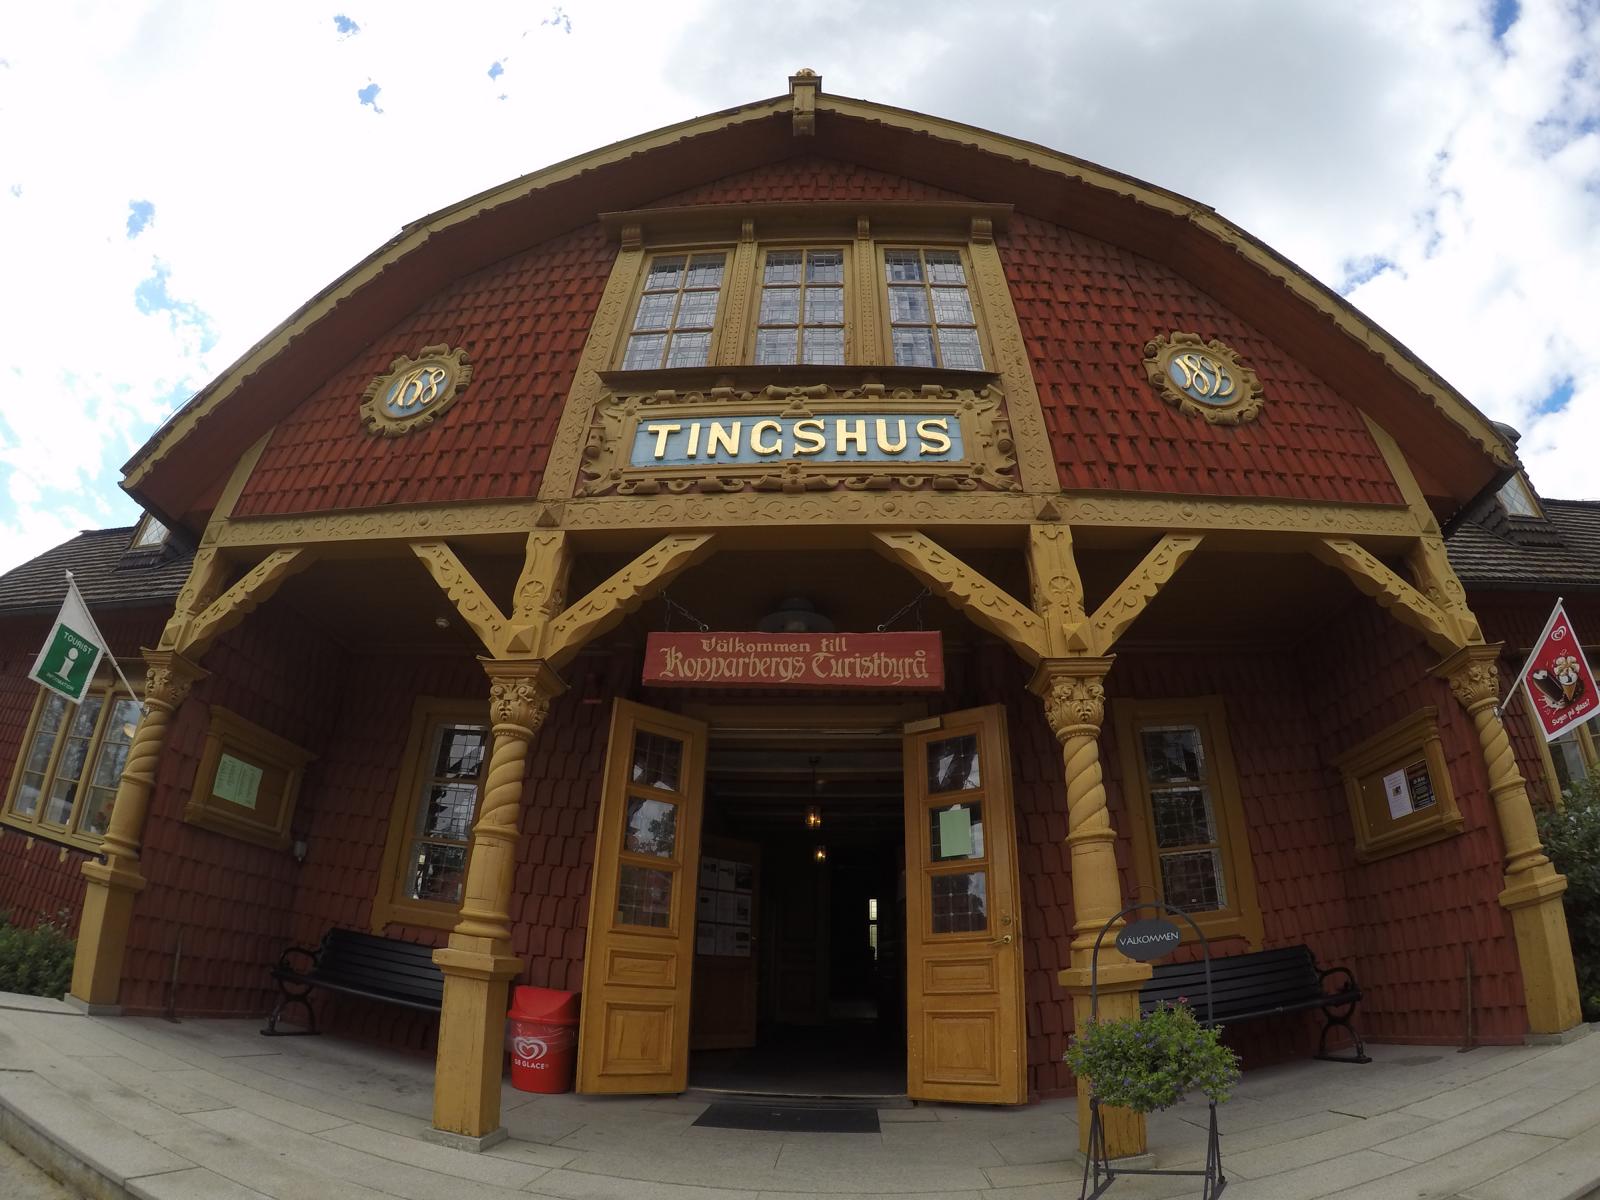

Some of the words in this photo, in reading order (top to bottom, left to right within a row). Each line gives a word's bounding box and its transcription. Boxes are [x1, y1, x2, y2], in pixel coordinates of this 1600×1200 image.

[647, 417, 952, 460] TINGSHUS
[63, 631, 93, 655] TOURIST
[701, 636, 811, 653] Välkommen
[821, 636, 848, 653] till
[659, 645, 806, 682] Kopparbergs
[812, 650, 929, 685] Turistbyrå
[1119, 931, 1179, 946] VÄLKOMMEN
[522, 1060, 545, 1070] GLACE
